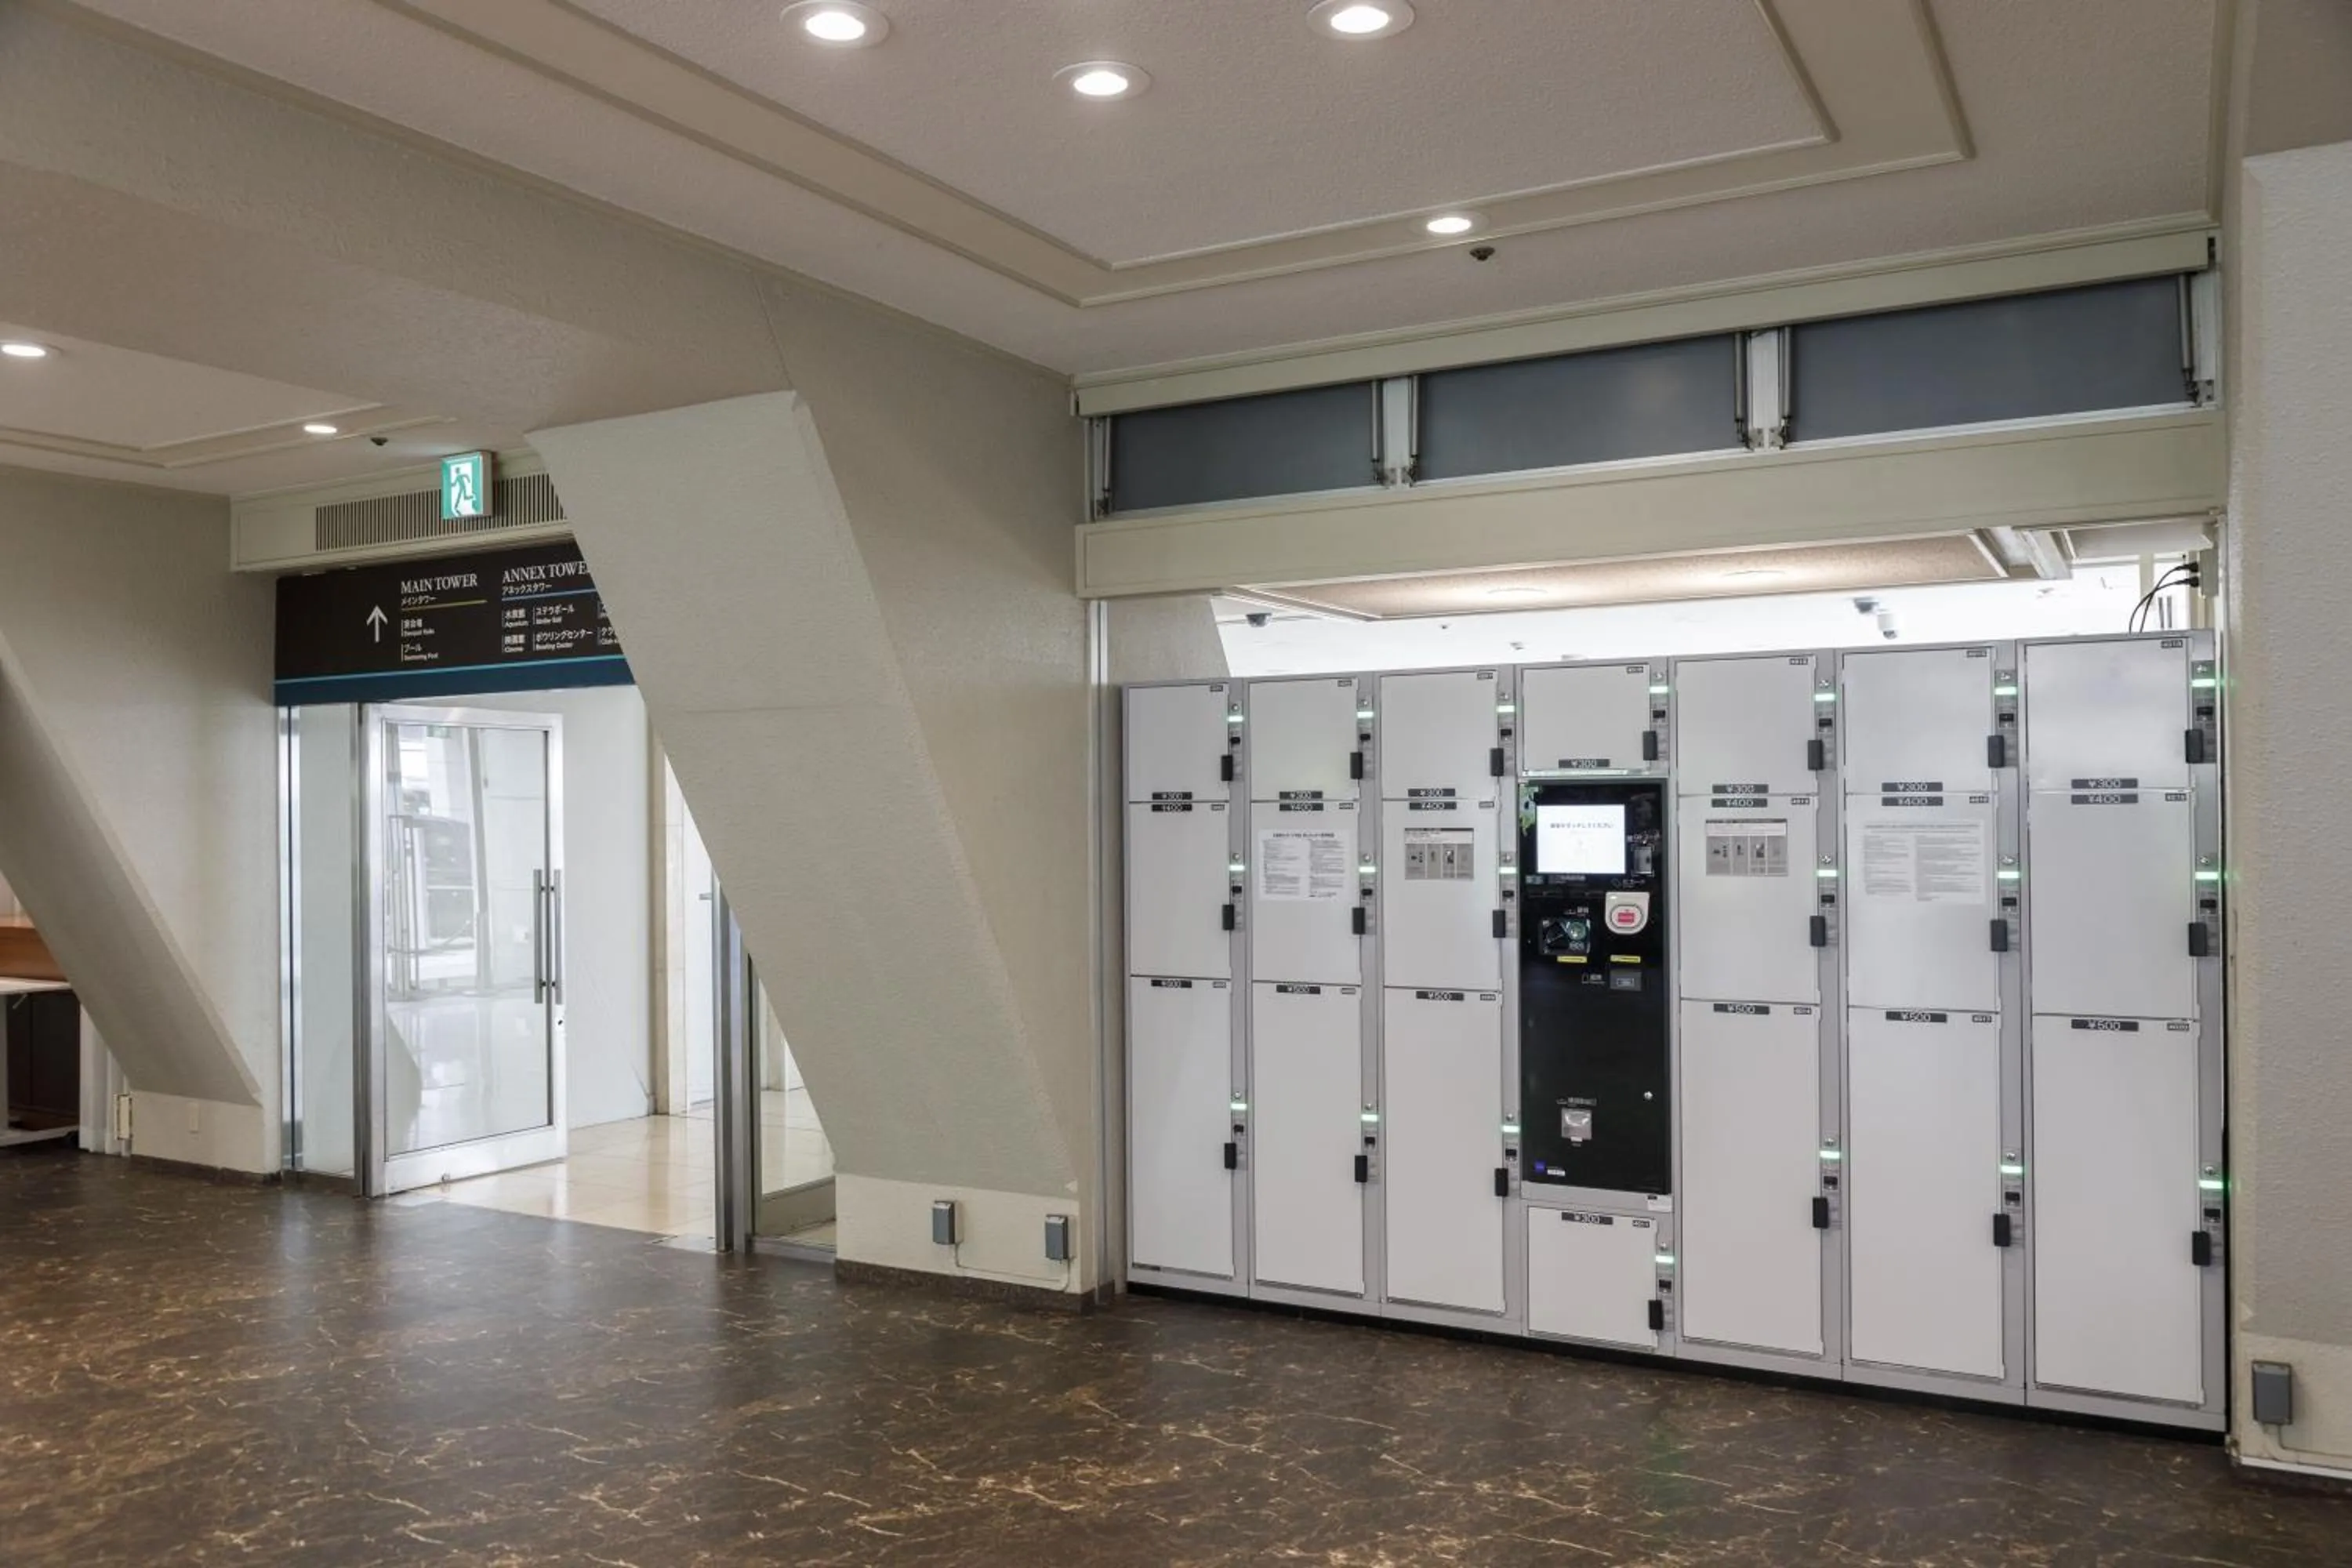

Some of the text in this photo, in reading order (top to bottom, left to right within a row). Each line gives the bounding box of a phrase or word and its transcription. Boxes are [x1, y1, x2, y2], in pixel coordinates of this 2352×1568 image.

[502, 564, 546, 583] ANNEX
[401, 573, 477, 594] MAIN TOWER
[502, 583, 552, 595] アネックスタワー
[401, 594, 438, 607] メインタワー
[1726, 784, 1755, 793] ¥300
[1897, 782, 1928, 792] ¥300
[2089, 778, 2122, 788] ¥300
[1726, 798, 1754, 808] ¥400
[1898, 797, 1929, 806] ¥400
[2088, 793, 2121, 804] ¥400
[1900, 1011, 1931, 1022] ¥500
[2088, 1019, 2122, 1031] ¥500
